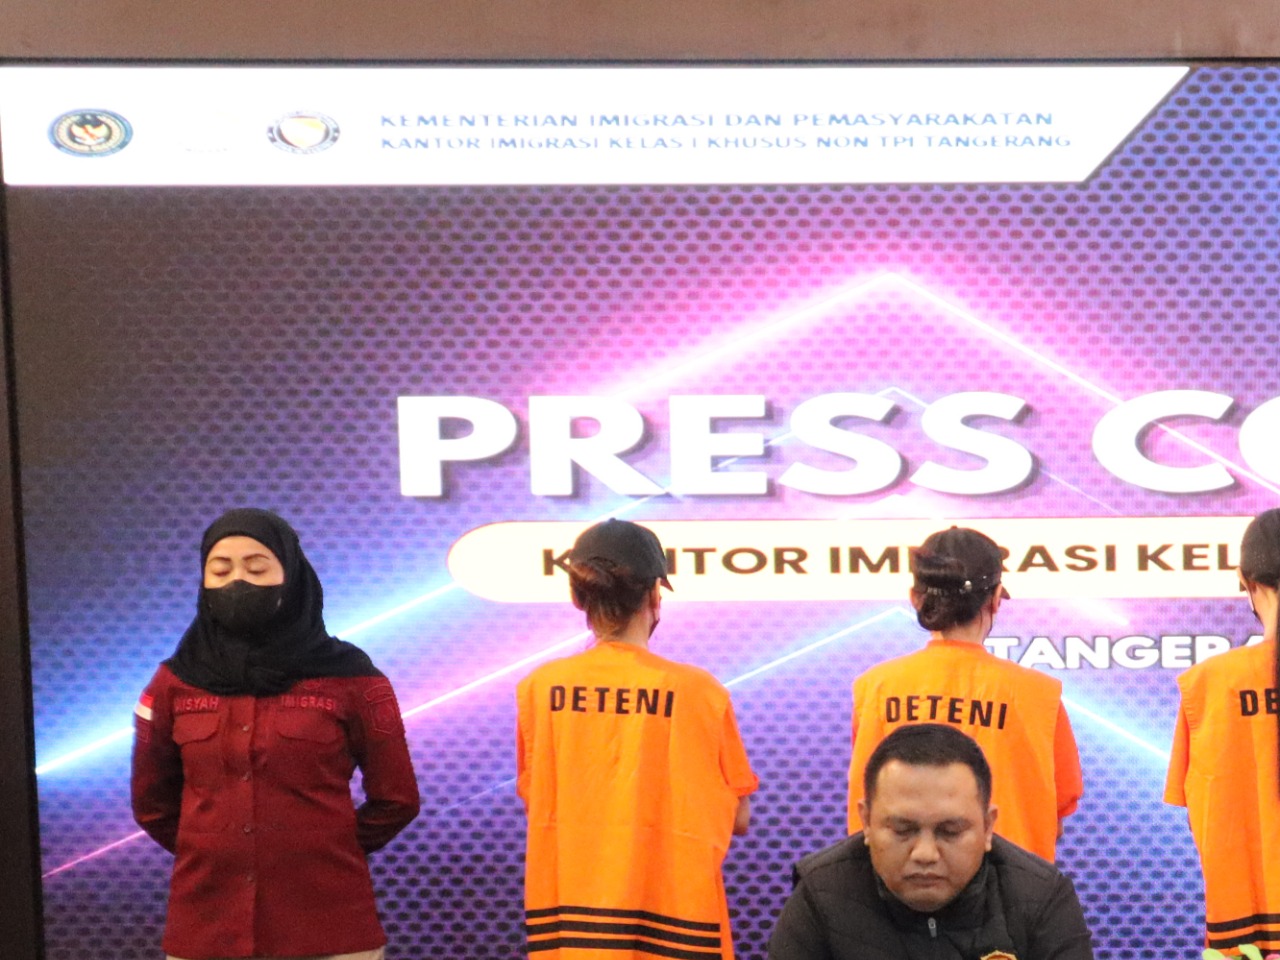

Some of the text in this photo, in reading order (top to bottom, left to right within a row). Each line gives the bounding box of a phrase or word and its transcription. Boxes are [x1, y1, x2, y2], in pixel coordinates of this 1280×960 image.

[381, 112, 1053, 127] KEMENTERIAN IMIGRASI DAN PEMASYARAKATAN
[381, 137, 481, 149] KANTOR
[491, 137, 598, 149] IMIGRASI
[609, 137, 683, 148] KELAS
[707, 136, 807, 148] KHUSUS
[817, 136, 868, 147] NON
[880, 136, 914, 147] TPI
[926, 135, 1071, 147] TANGERANG
[399, 390, 1034, 498] PRESS
[543, 547, 808, 576] KTOR
[550, 685, 675, 718] DETENI
[885, 695, 1008, 730] DETENI
